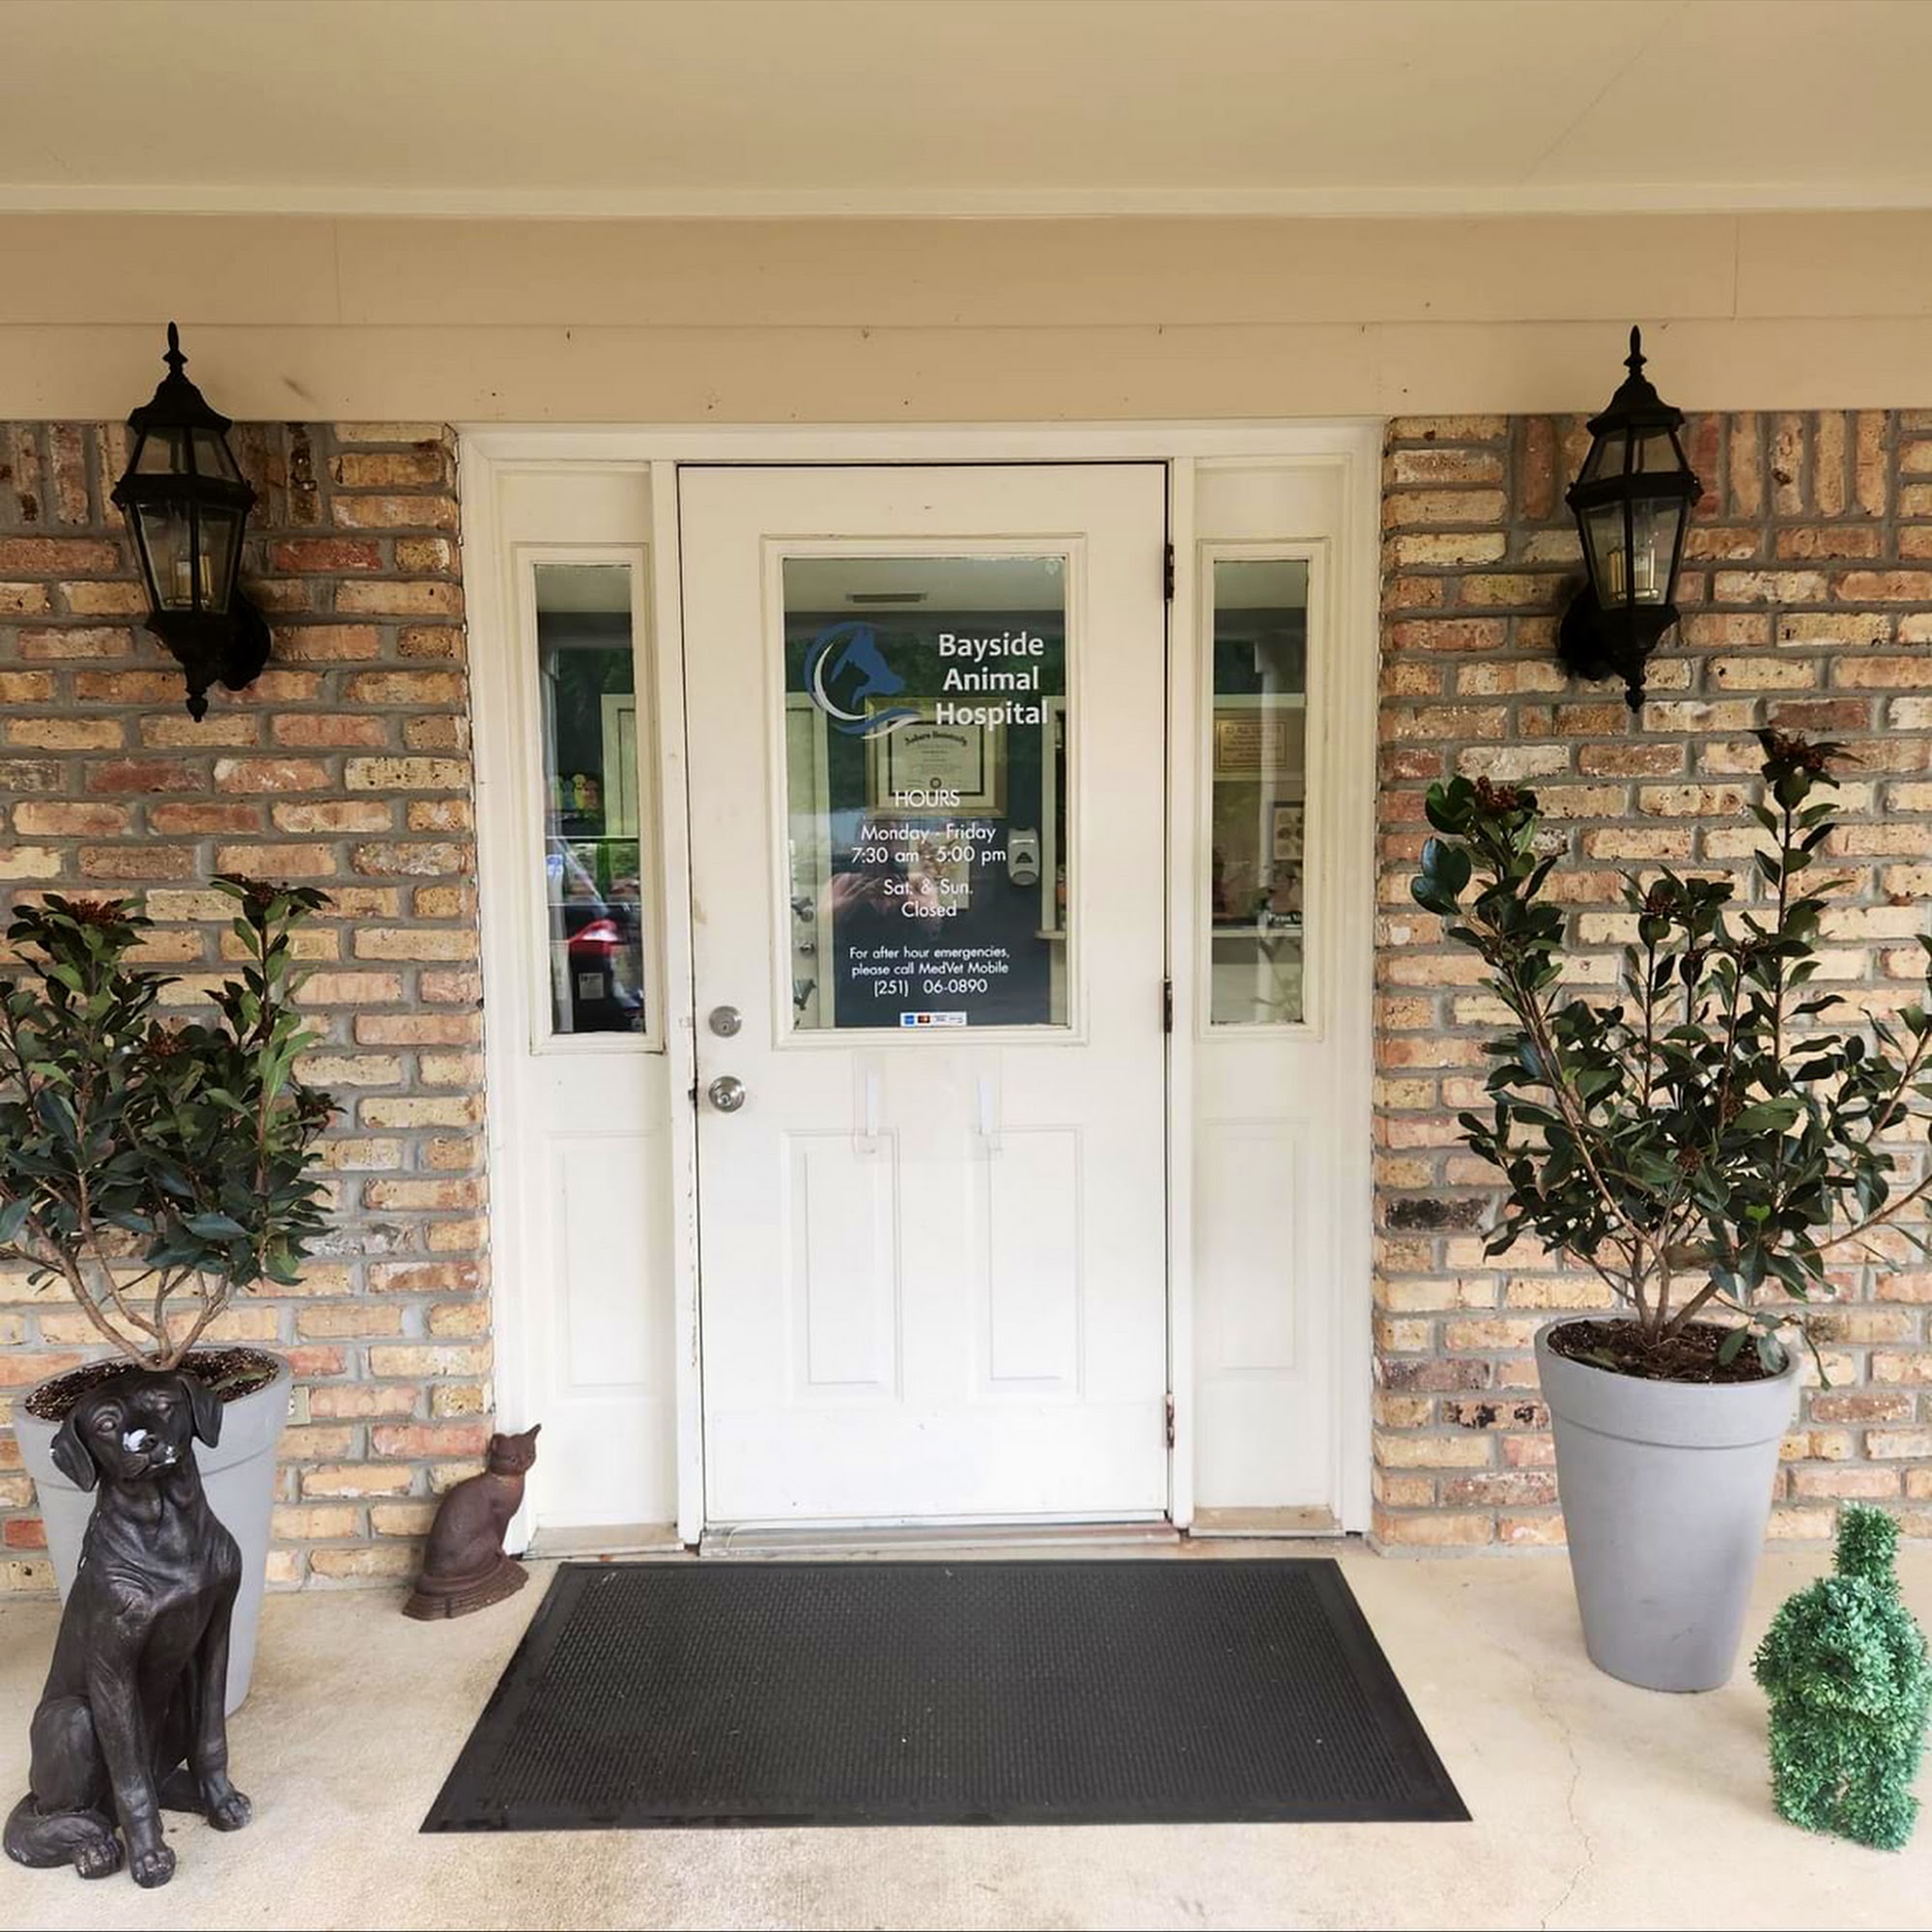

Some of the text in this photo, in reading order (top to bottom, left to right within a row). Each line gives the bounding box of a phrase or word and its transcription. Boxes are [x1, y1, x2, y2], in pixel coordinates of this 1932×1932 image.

[938, 632, 1044, 663] Bayside
[942, 666, 1039, 691] Animal
[935, 699, 1048, 731] Hospital
[895, 789, 960, 808] HOURS
[861, 824, 929, 844] Monday
[946, 822, 996, 843] Friday
[851, 847, 889, 864] 7:30
[895, 852, 919, 863] am
[936, 846, 976, 863] 5:00
[981, 851, 1007, 866] pm
[883, 878, 974, 895] Sat. & Sun.
[901, 900, 957, 918] Closed
[849, 946, 868, 959] For
[872, 946, 899, 959] after
[903, 946, 929, 958] hour
[851, 960, 1009, 979] please call MedVet Mobile
[874, 980, 909, 998] (251)
